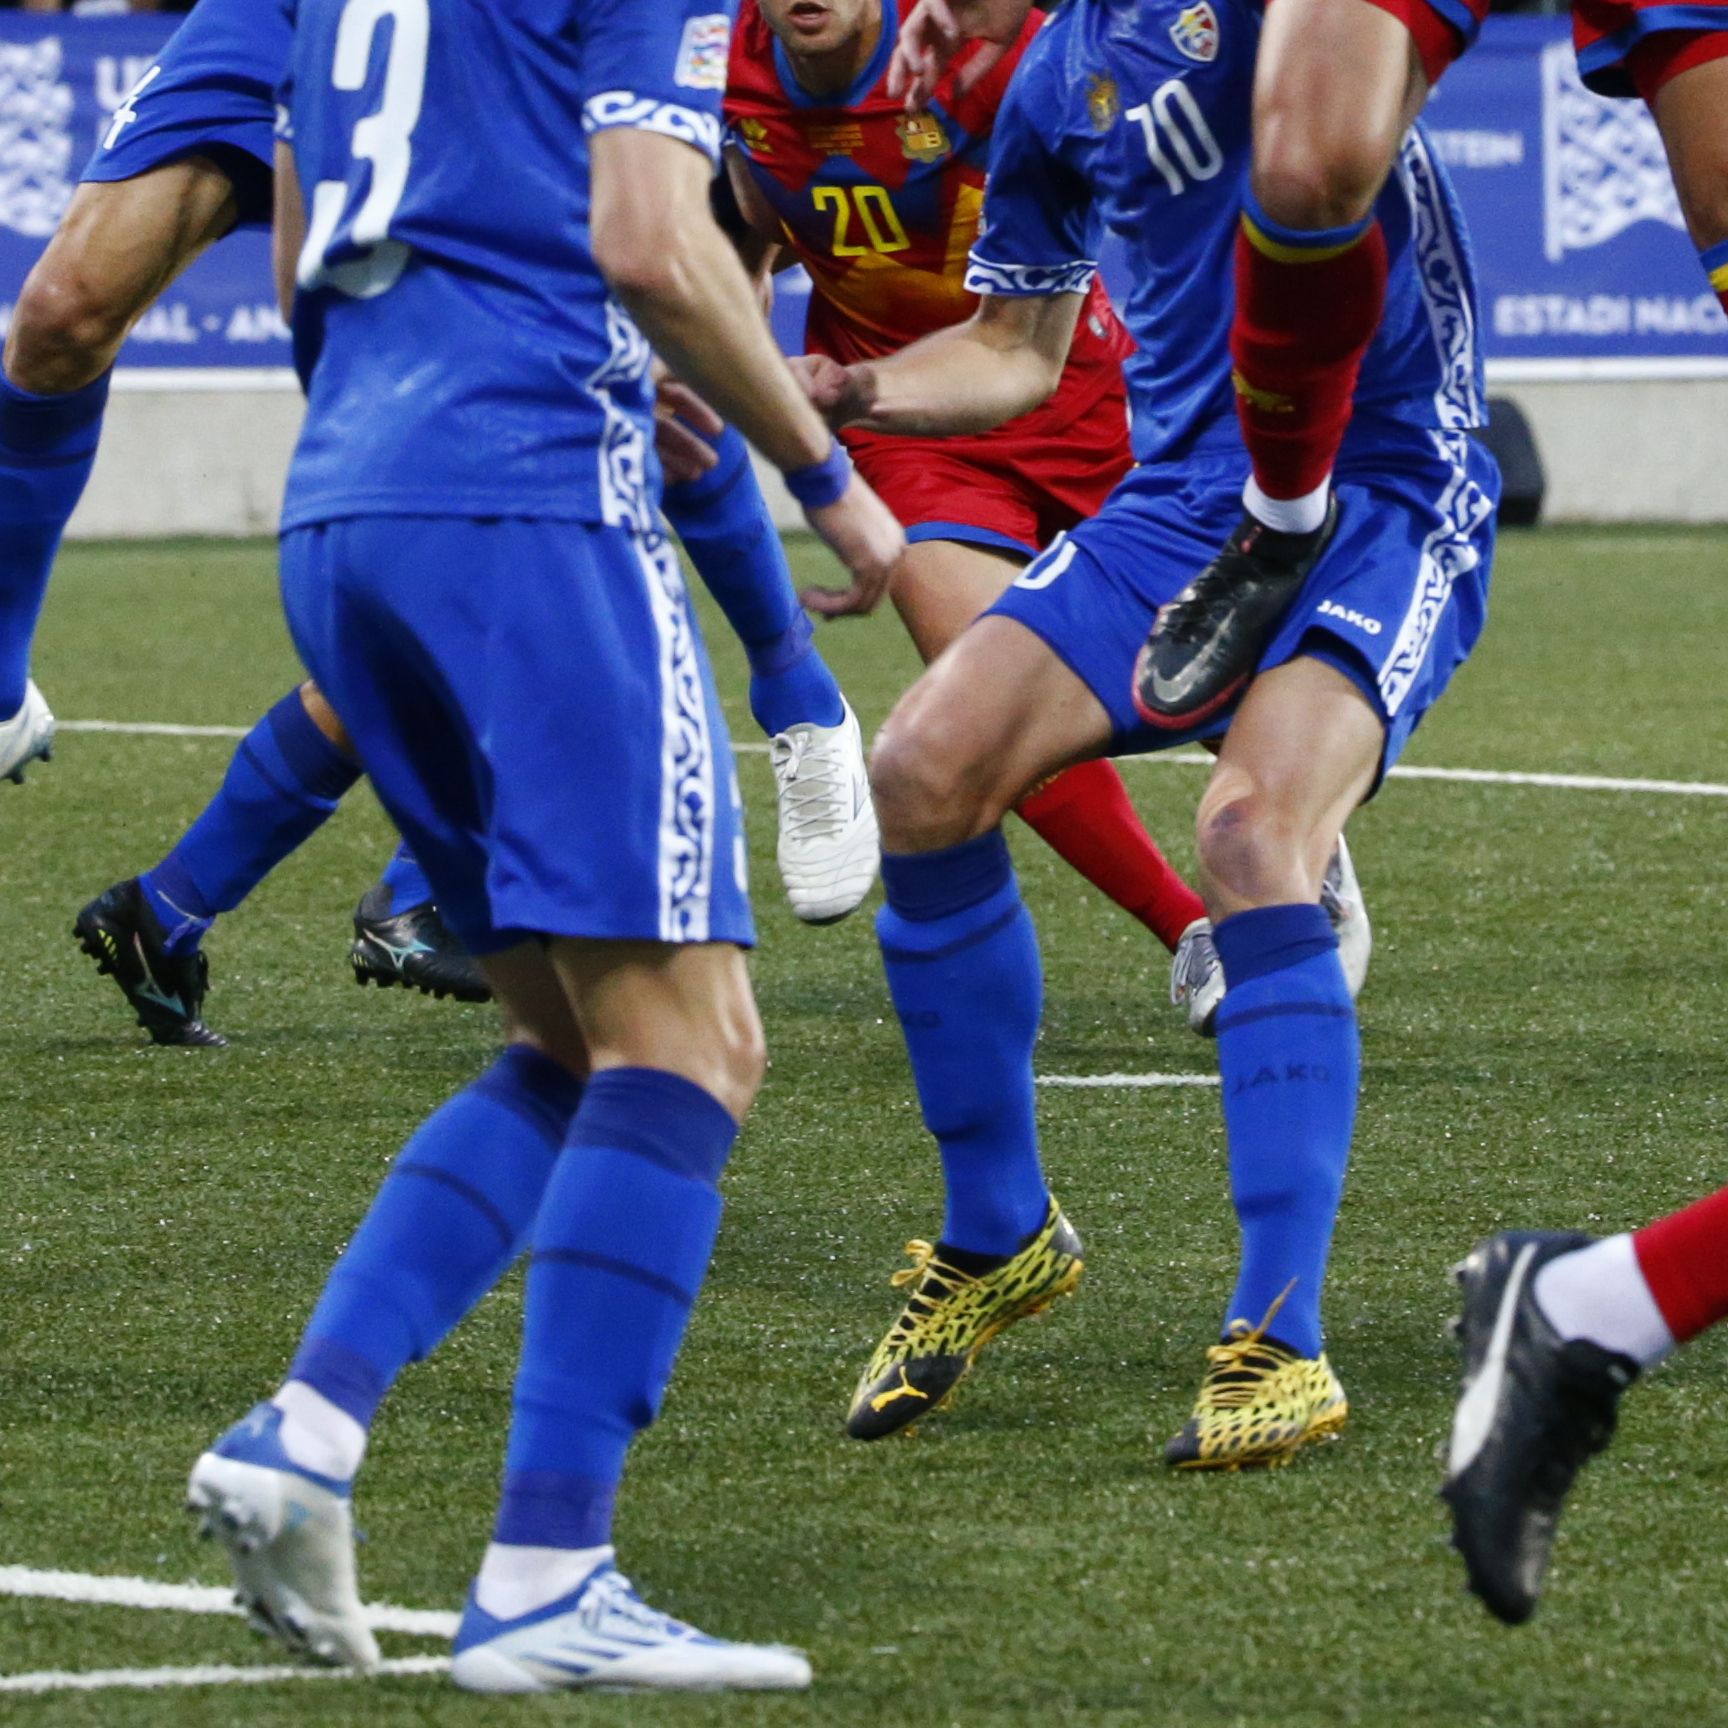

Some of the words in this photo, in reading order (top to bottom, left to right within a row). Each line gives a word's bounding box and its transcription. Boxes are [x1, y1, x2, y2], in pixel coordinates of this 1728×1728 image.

[1125, 78, 1225, 196] 10
[811, 185, 911, 257] 20
[1012, 529, 1078, 591] 0
[1316, 599, 1383, 636] JAKO
